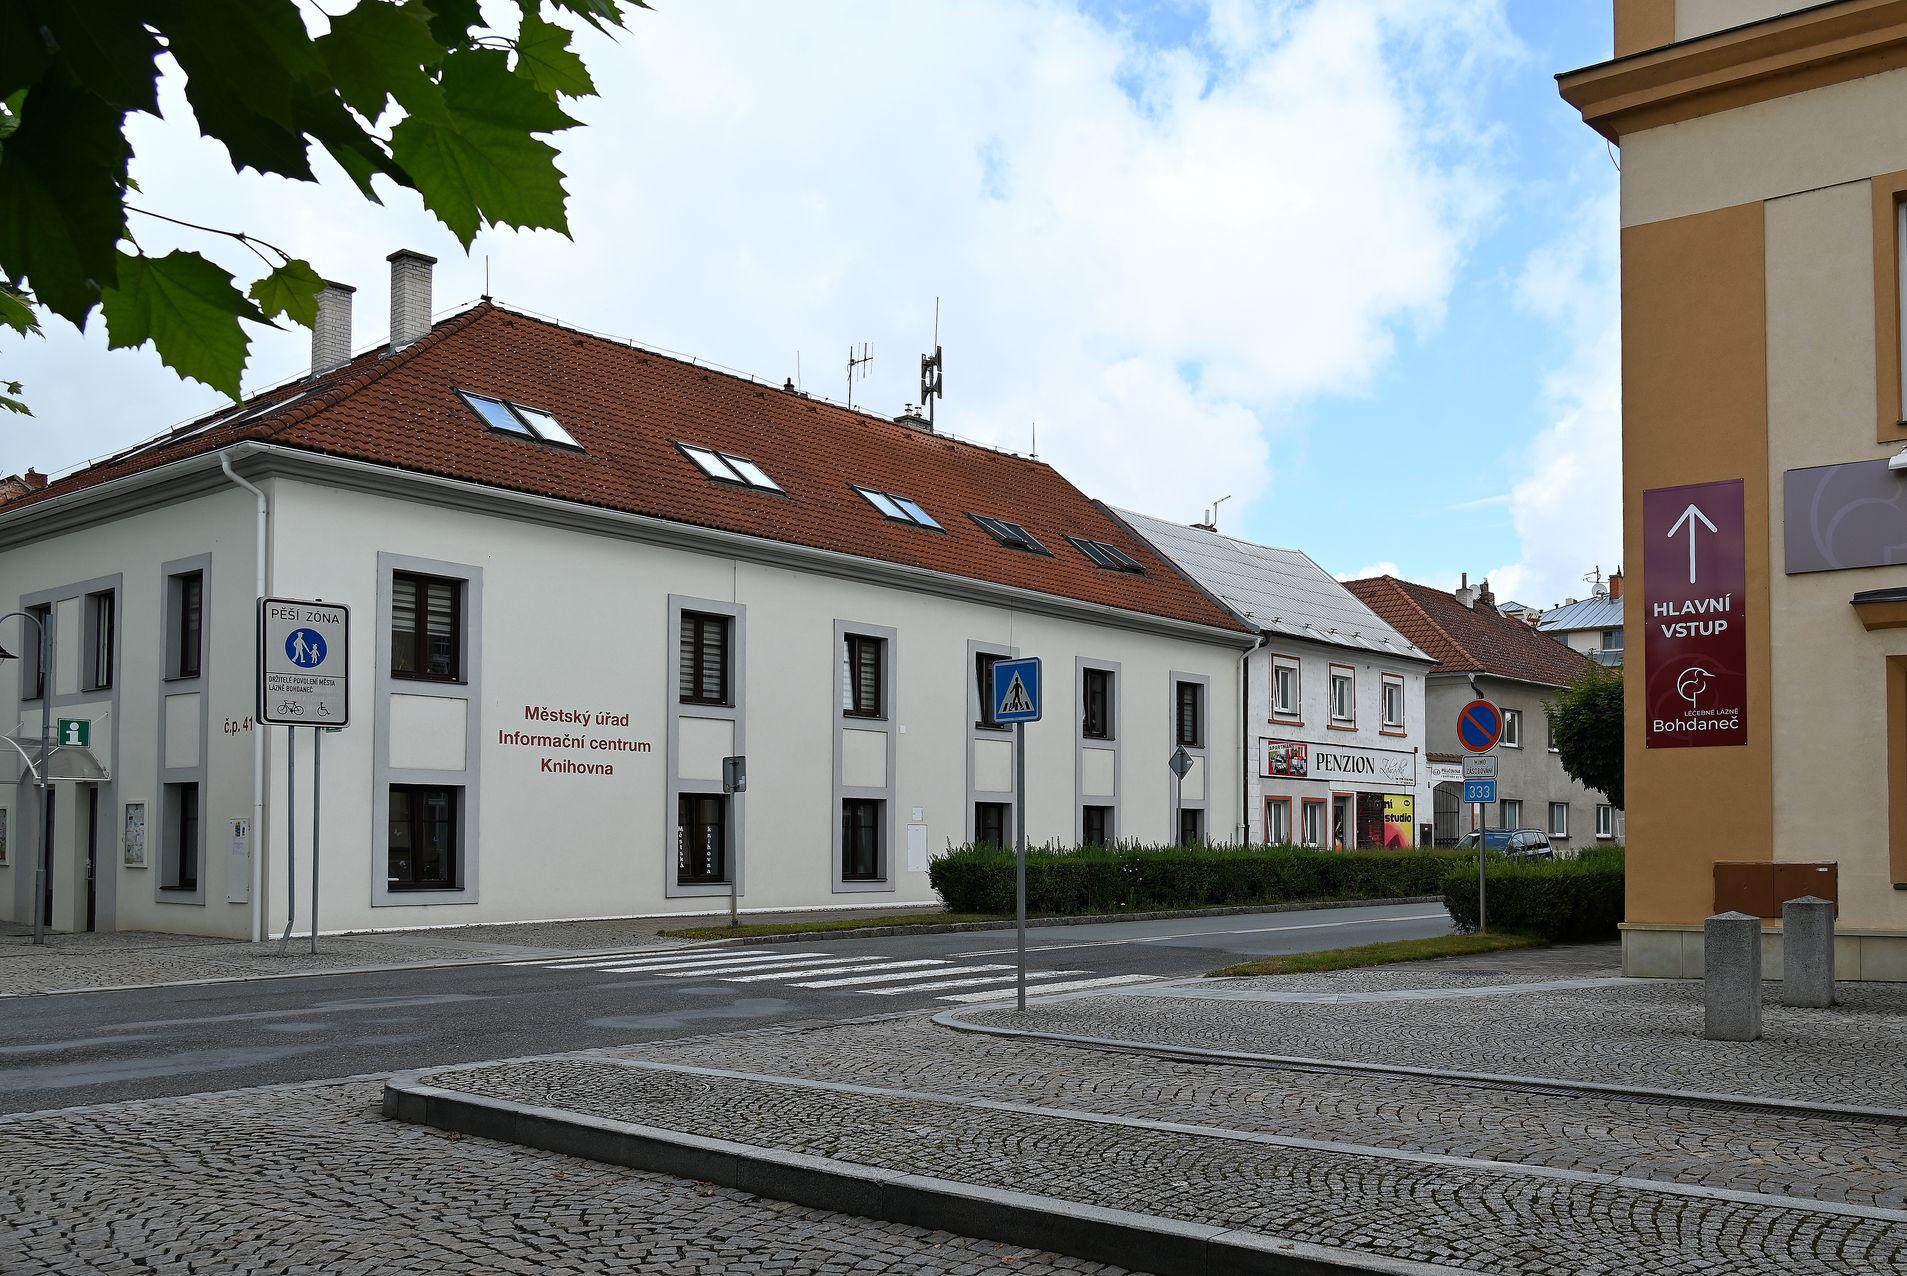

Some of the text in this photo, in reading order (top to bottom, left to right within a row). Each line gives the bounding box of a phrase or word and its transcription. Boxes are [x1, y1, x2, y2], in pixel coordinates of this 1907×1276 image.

[1653, 593, 1732, 617] HLAVNÍ
[271, 607, 340, 624] PĚŠÍ ZÓNA
[1661, 620, 1728, 638] VSTUP
[524, 705, 630, 727] Městský úřad
[1716, 707, 1739, 715] LÁZNĚ
[224, 716, 253, 737] č.p. 41
[1653, 716, 1739, 732] Bohdaneč
[498, 730, 651, 753] Informační centrum
[541, 758, 614, 775] Knihovna
[1316, 752, 1375, 775] PENZION
[1469, 785, 1491, 799] 333
[1384, 813, 1412, 823] studio
